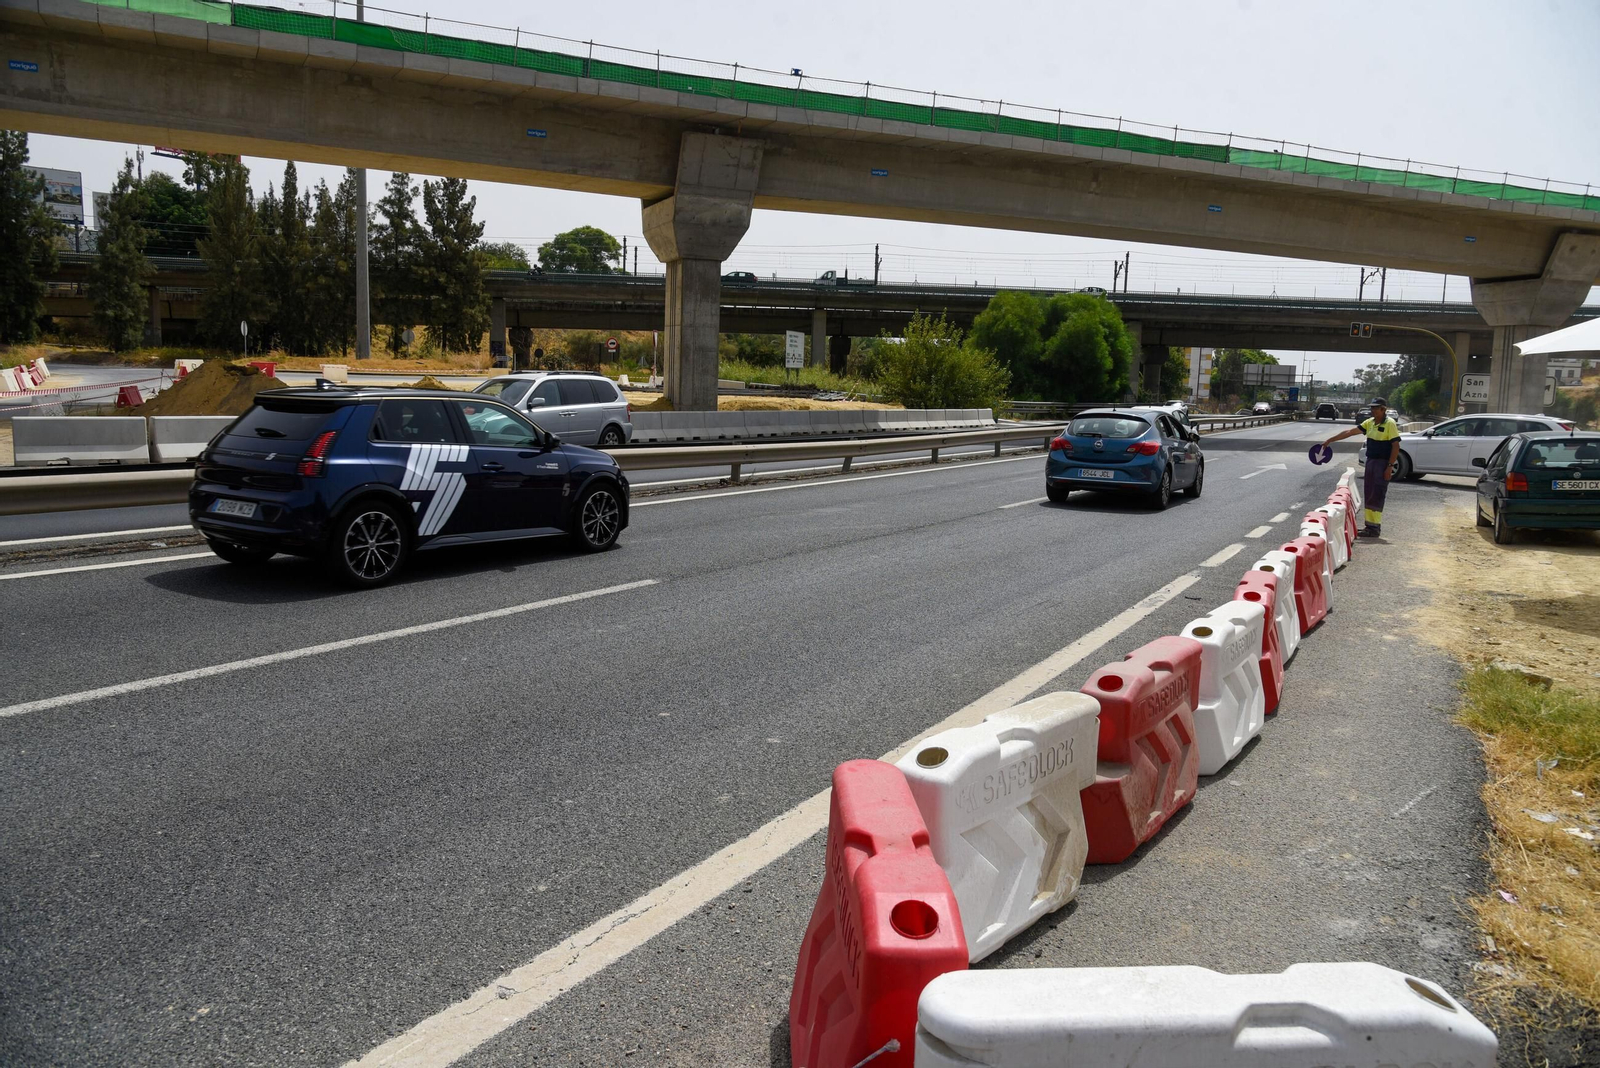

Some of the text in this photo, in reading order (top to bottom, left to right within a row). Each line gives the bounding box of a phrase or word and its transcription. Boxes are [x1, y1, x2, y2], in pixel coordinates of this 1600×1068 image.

[1466, 378, 1484, 386] San
[1557, 481, 1567, 489] SE
[1589, 481, 1600, 489] CX
